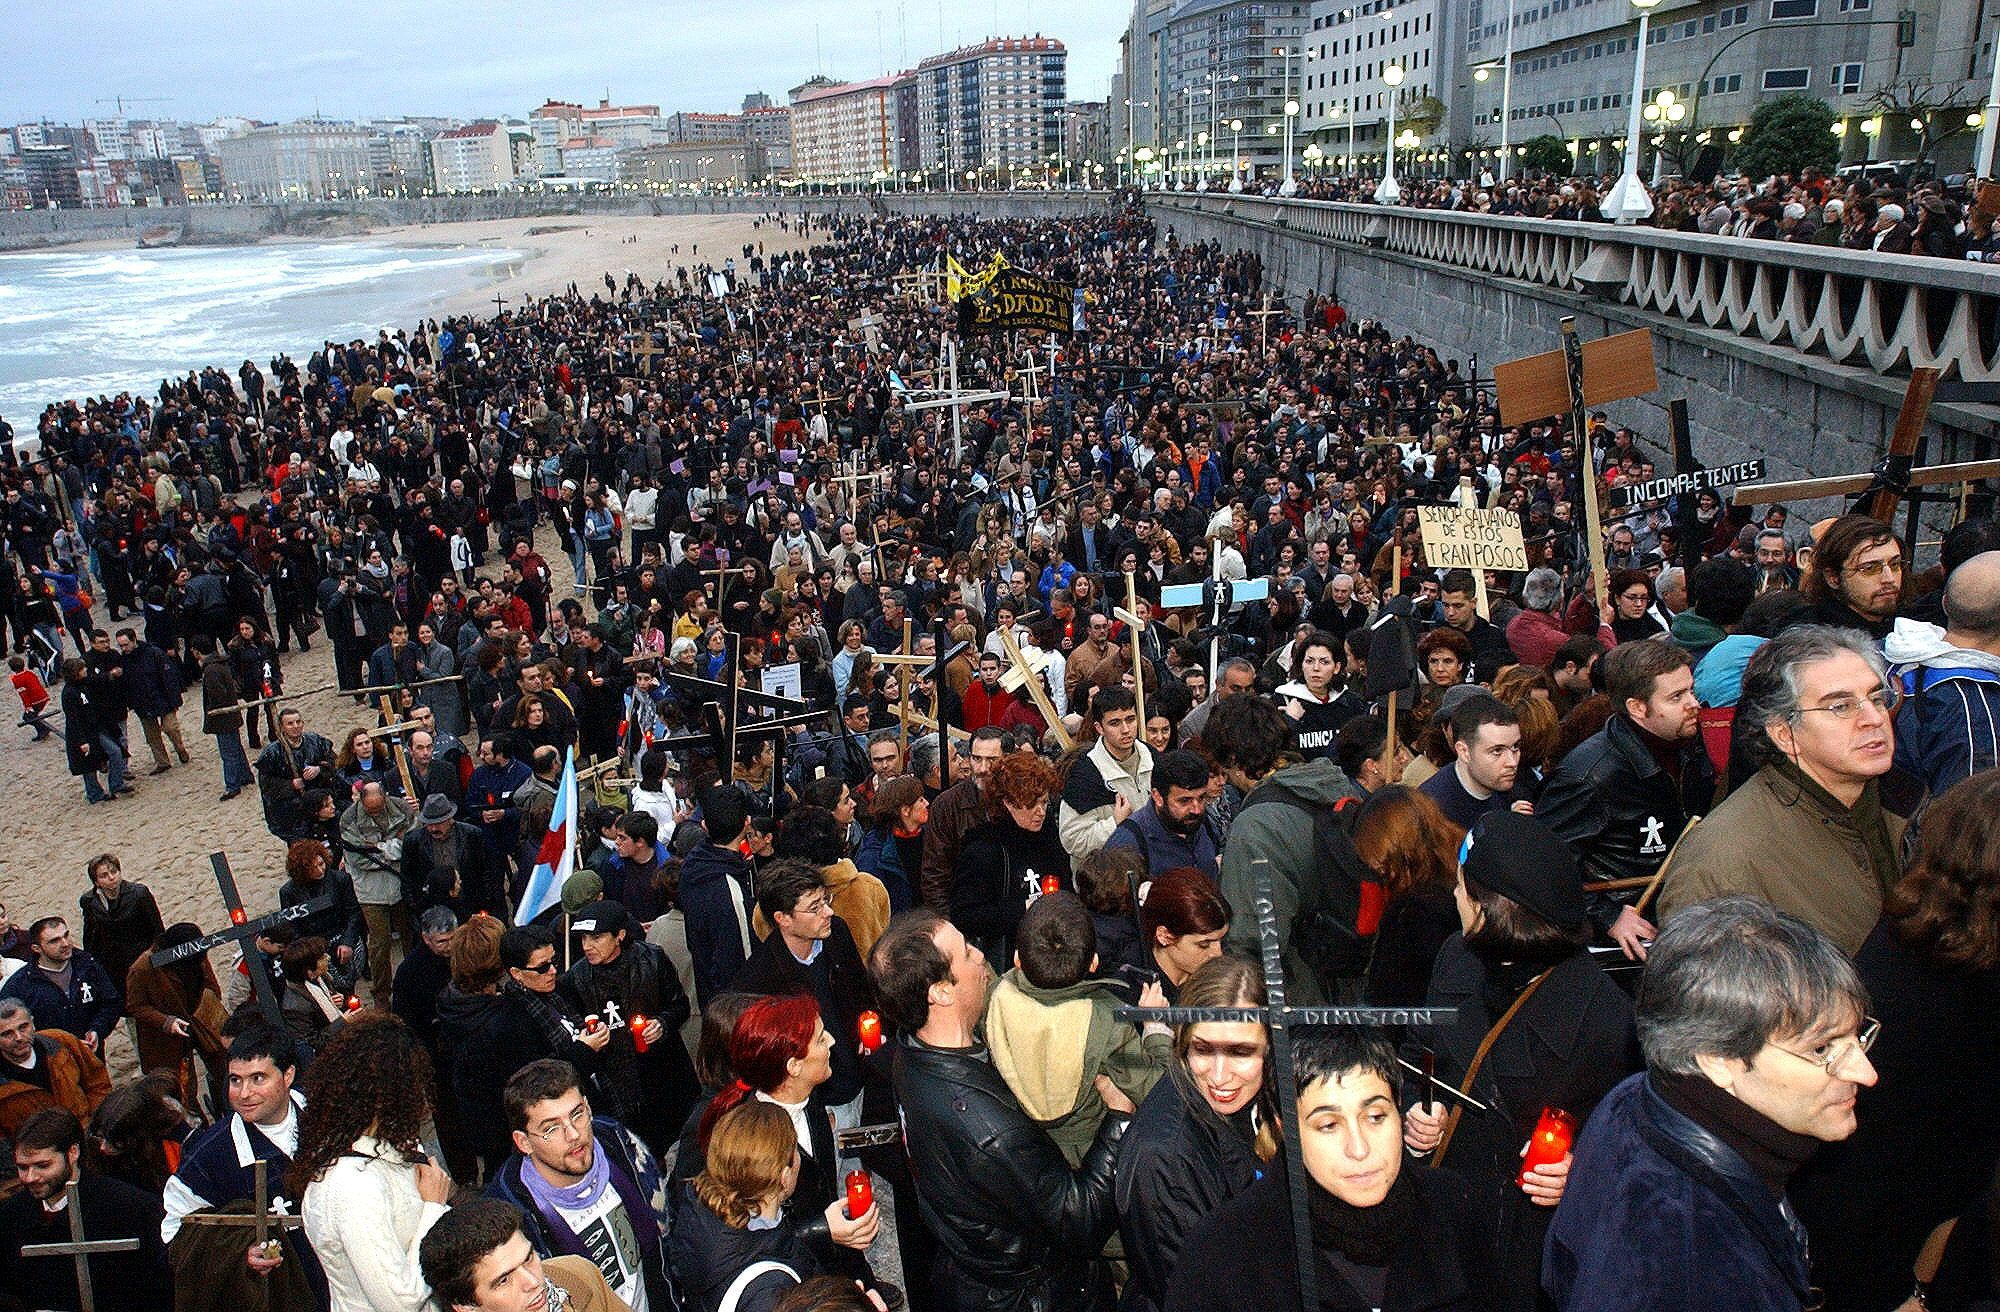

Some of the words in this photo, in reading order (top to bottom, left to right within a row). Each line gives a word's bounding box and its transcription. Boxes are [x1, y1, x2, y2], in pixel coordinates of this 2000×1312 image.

[1442, 523, 1456, 537] DE
[1463, 524, 1504, 543] ESTOS
[1304, 1009, 1433, 1026] DIMISION
